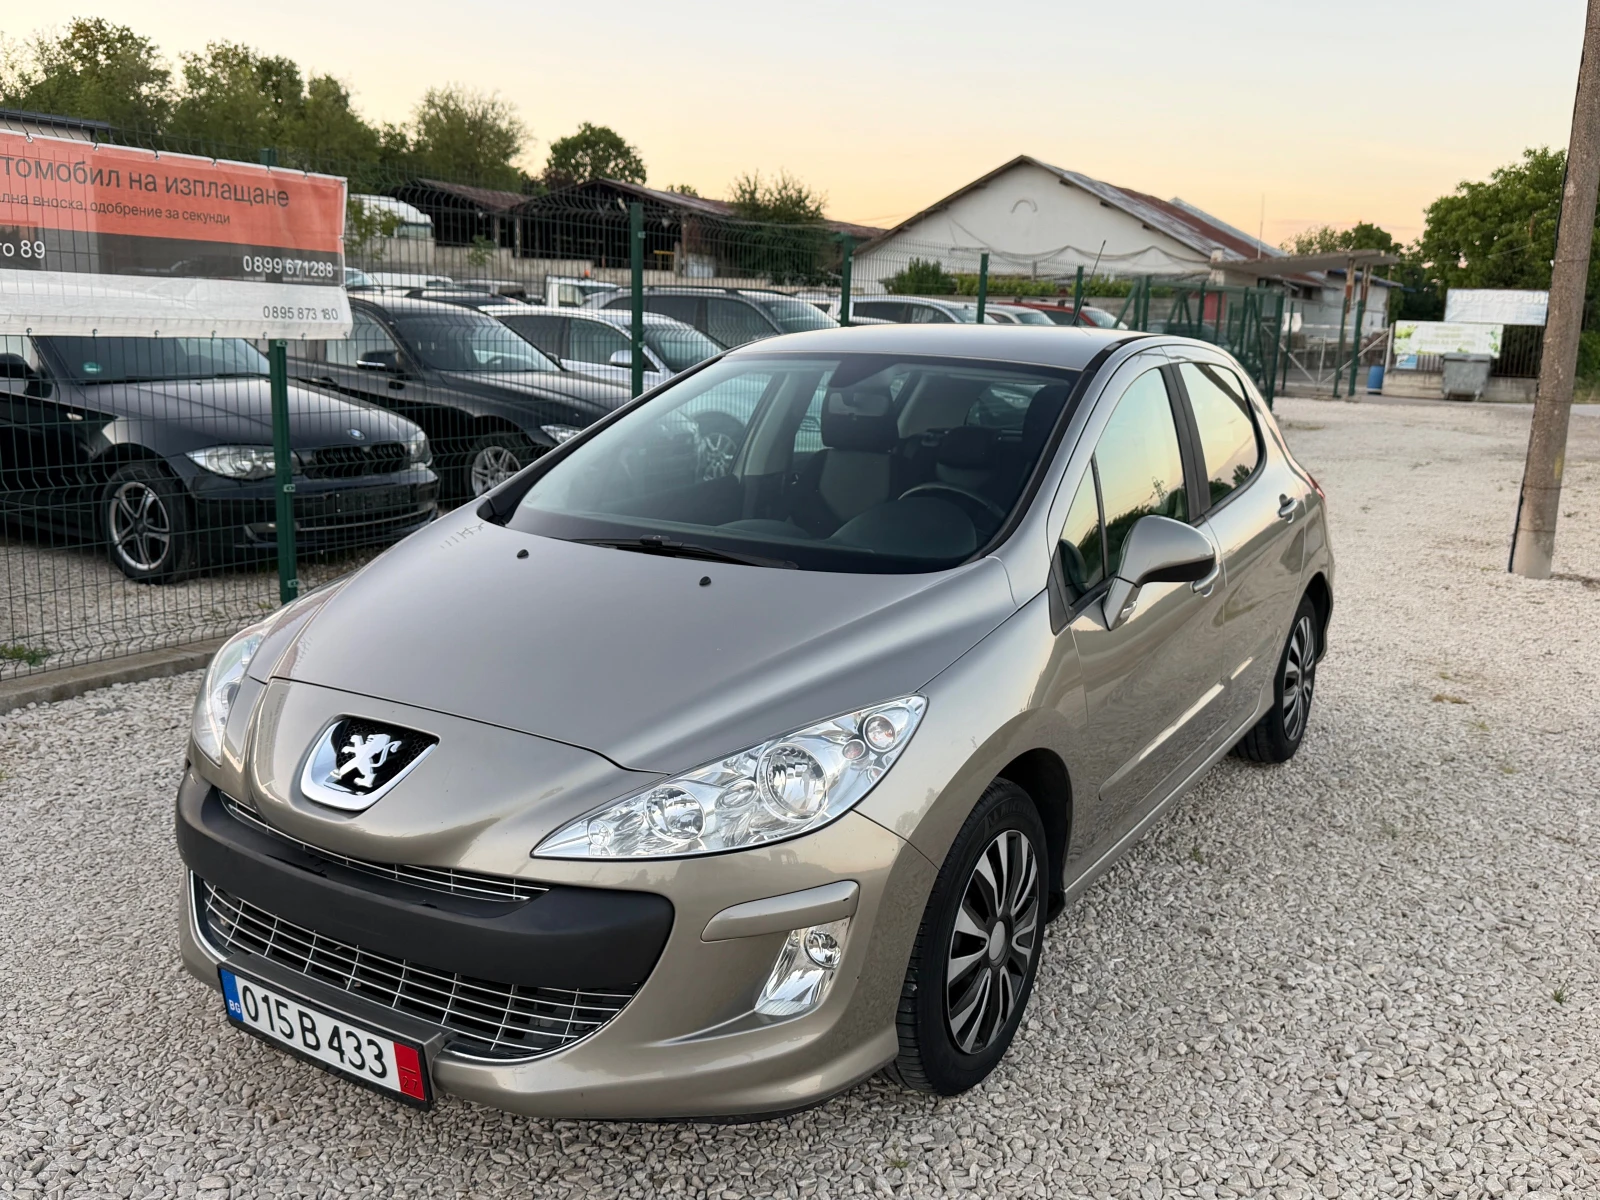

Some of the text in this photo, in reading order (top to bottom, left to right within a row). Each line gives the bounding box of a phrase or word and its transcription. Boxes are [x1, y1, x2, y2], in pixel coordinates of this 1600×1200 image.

[0, 155, 289, 207] томобил на изплащане
[0, 193, 230, 224] лна вноска, одобрение за секунди
[0, 240, 45, 259] о 89
[243, 255, 333, 277] 0899 671288
[1451, 291, 1548, 304] АВТОСЕРВИ
[263, 305, 338, 320] 0895 873 180
[229, 999, 241, 1014] BG
[242, 985, 387, 1079] 015B433
